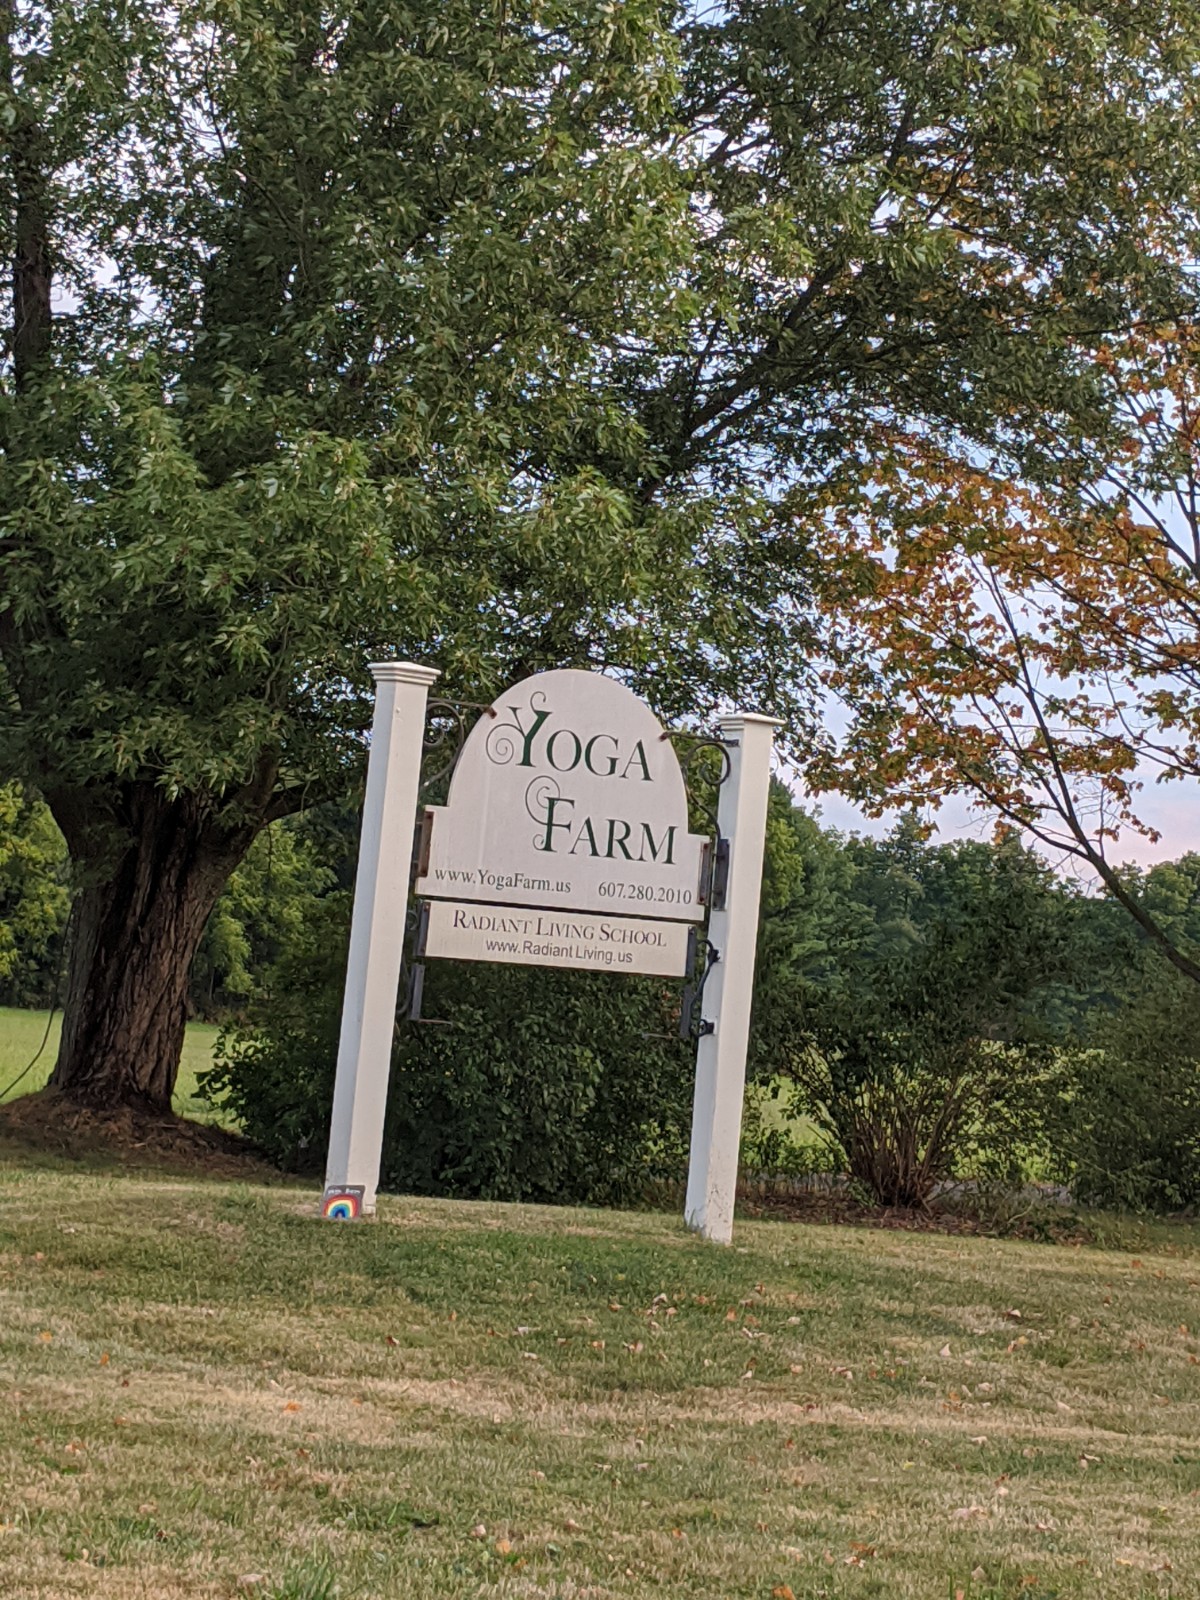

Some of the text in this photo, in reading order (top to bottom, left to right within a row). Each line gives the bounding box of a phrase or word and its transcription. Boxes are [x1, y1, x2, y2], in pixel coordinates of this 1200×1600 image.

[485, 690, 654, 782] YOGA
[525, 775, 679, 866] FARM
[434, 868, 571, 894] www.YogaFarm.us
[598, 881, 692, 905] 607.280.2010
[453, 909, 667, 948] RADIANT LIVING SCHOOL
